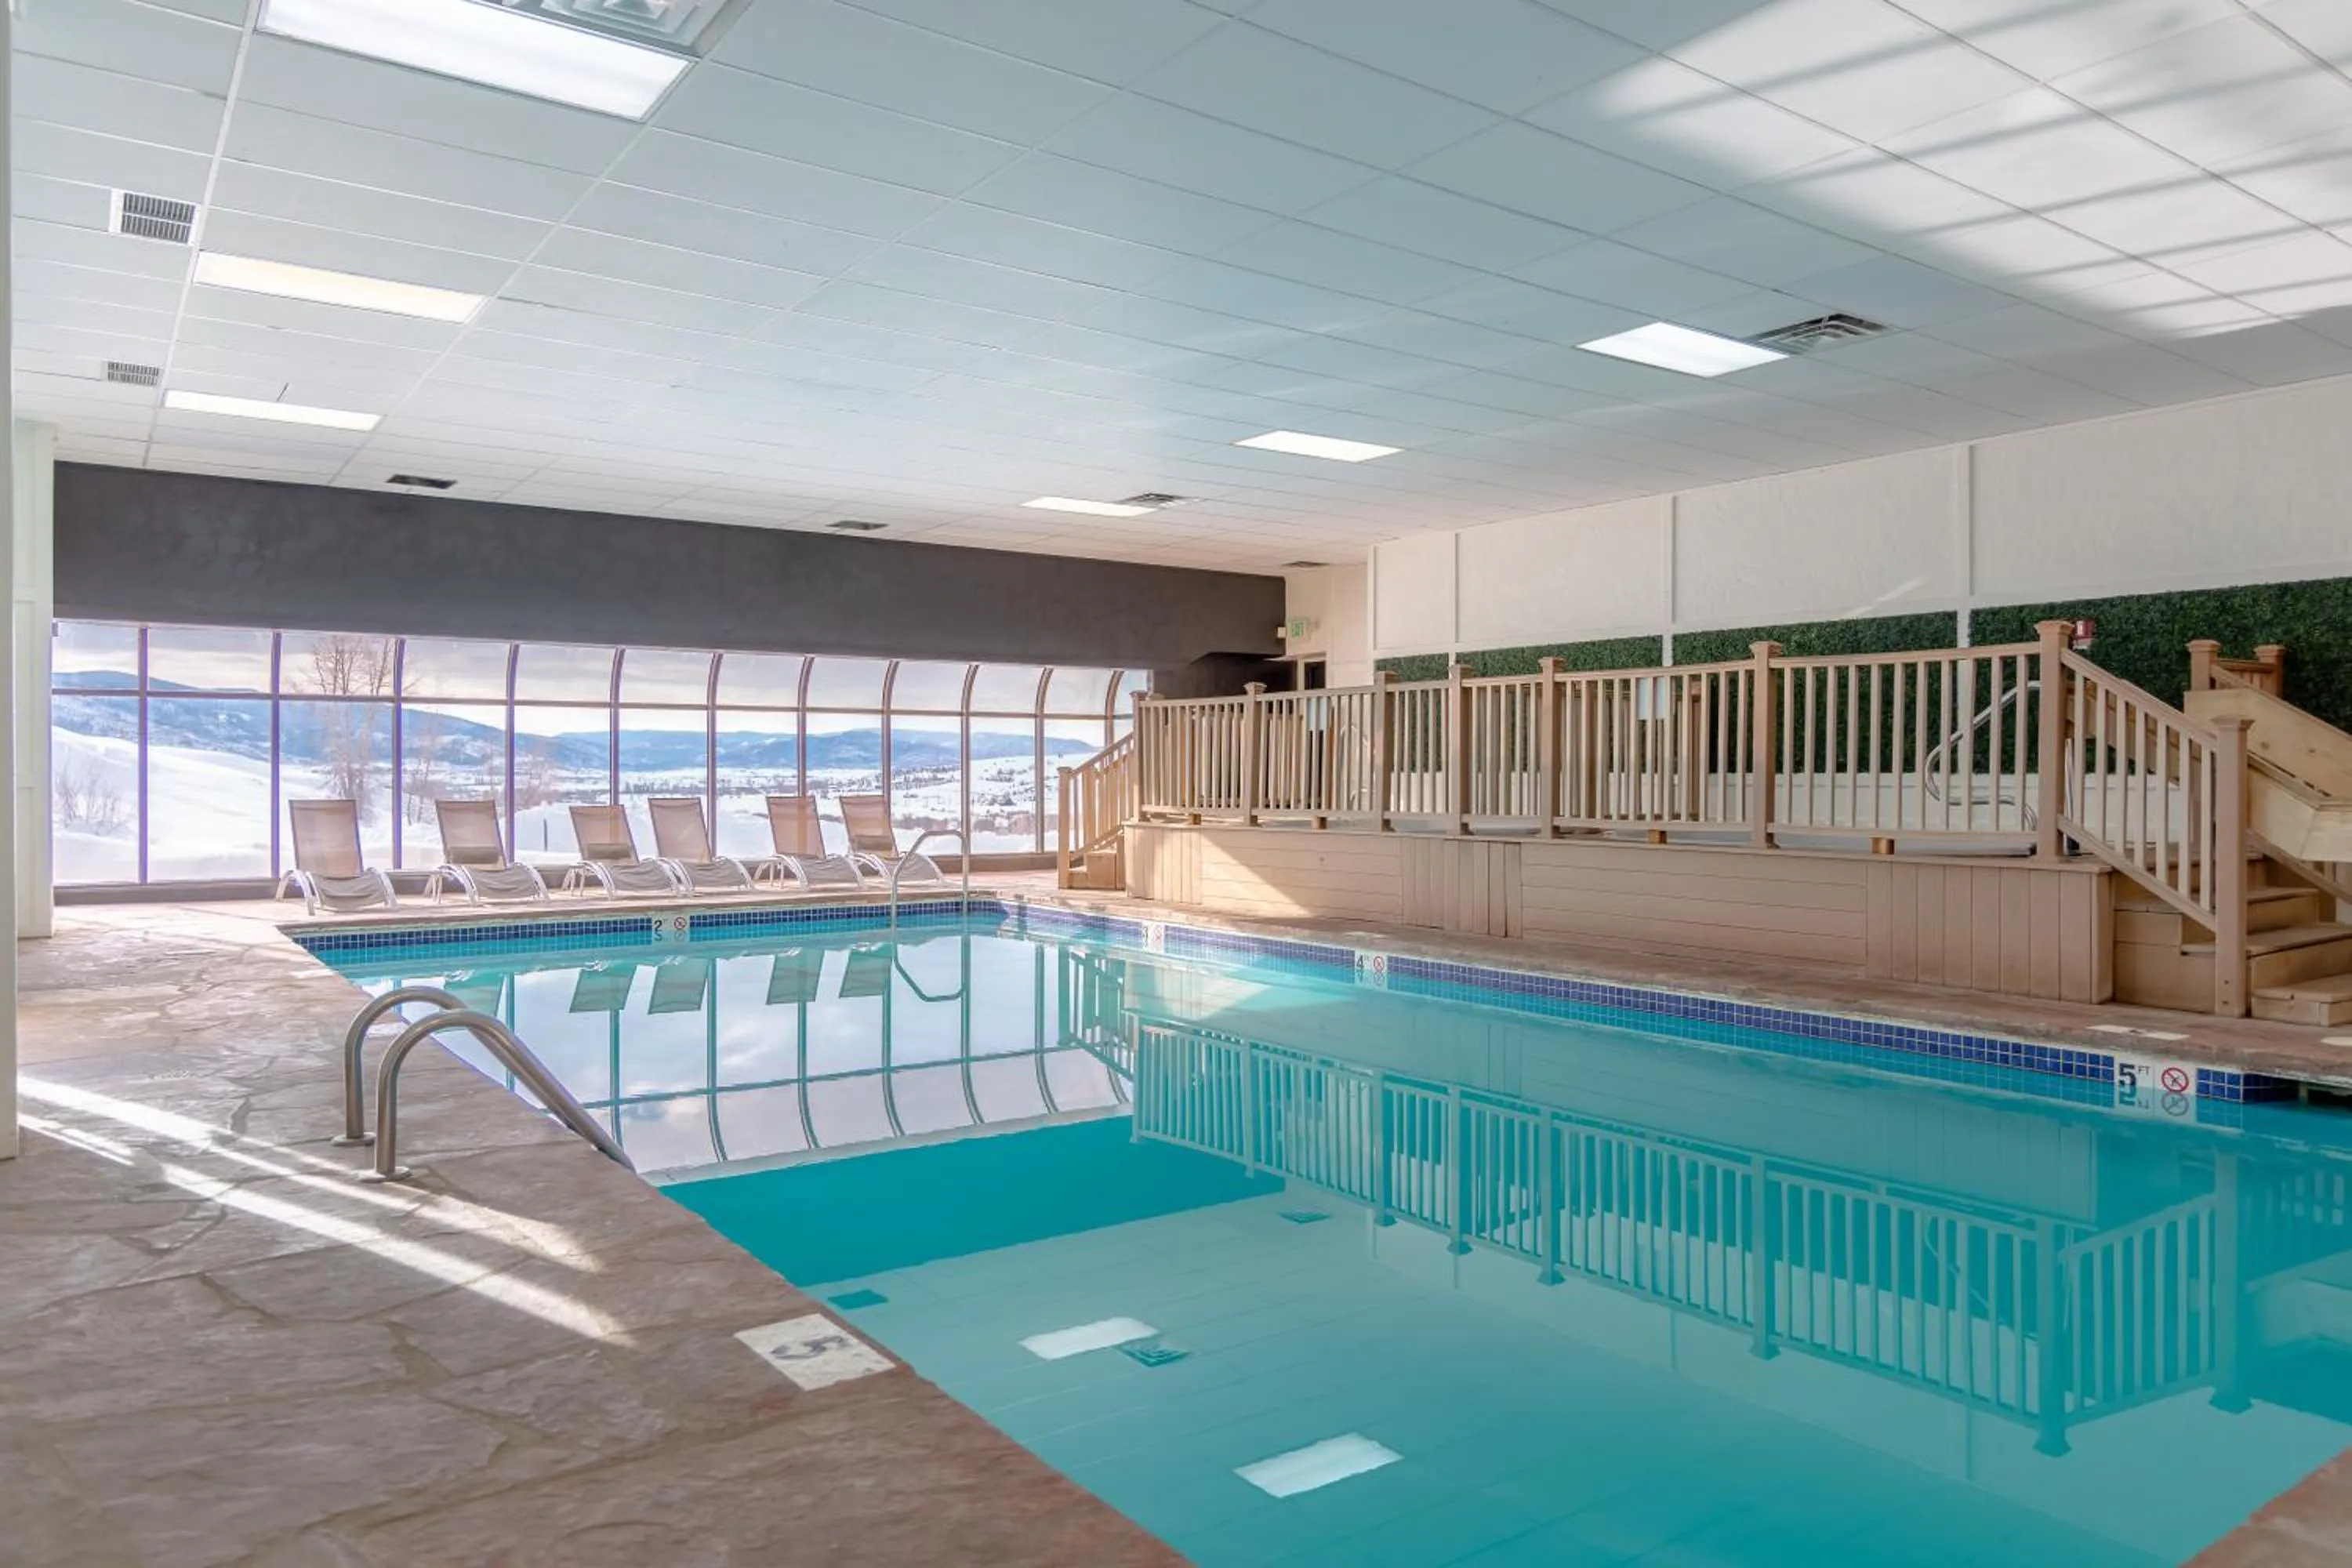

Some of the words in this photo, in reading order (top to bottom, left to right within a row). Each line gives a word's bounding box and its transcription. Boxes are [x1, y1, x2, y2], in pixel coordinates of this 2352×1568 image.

[654, 920, 662, 931] 2
[1356, 955, 1364, 969] 4
[2118, 1063, 2136, 1086] 5
[2138, 1065, 2150, 1076] FT
